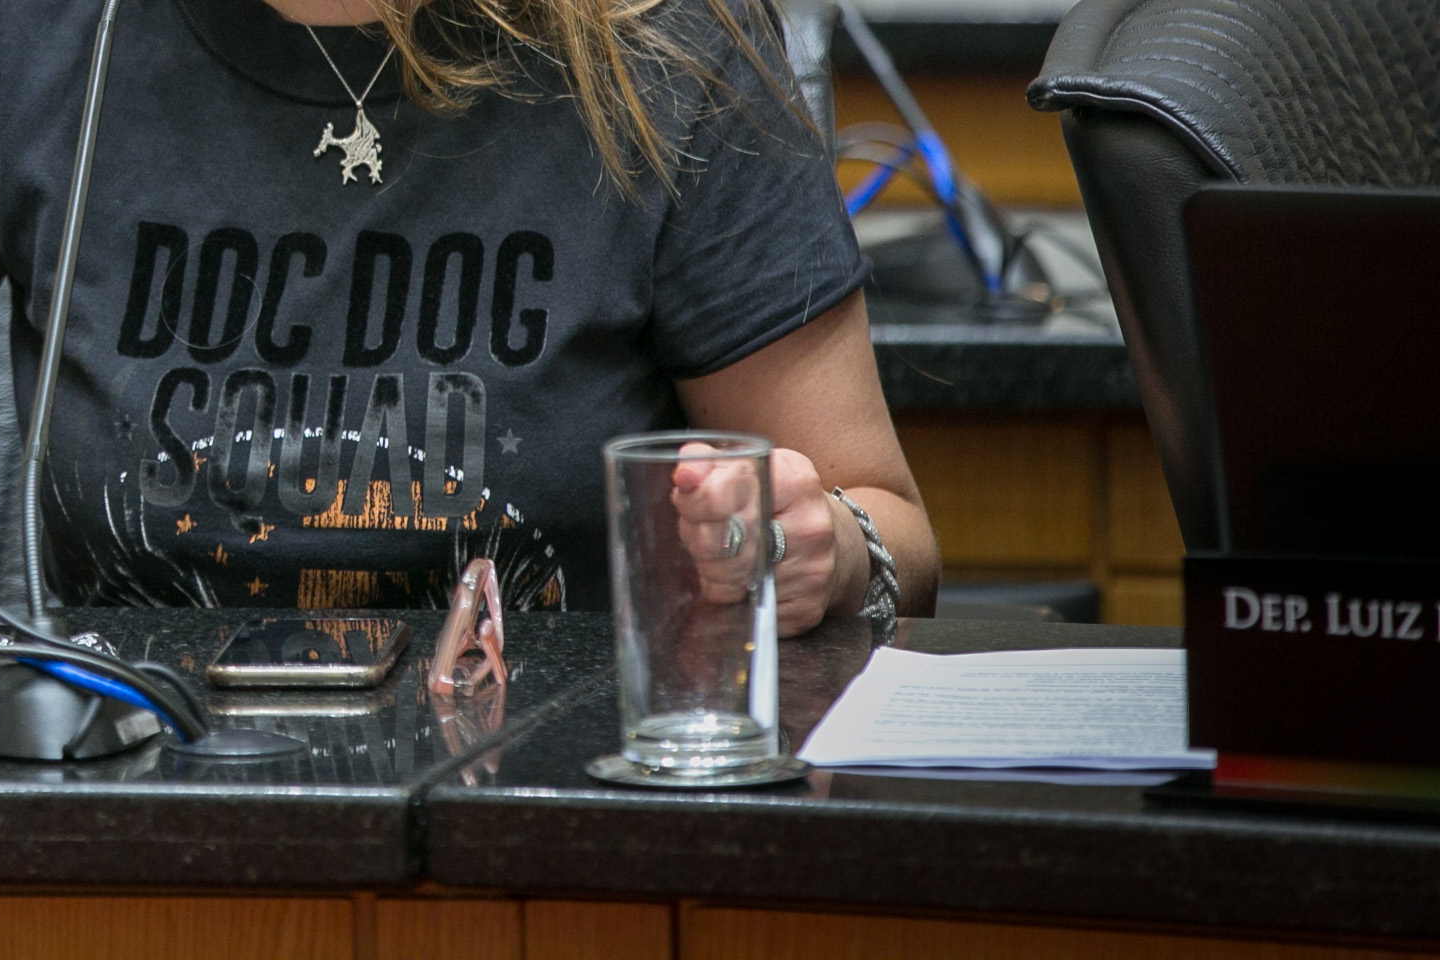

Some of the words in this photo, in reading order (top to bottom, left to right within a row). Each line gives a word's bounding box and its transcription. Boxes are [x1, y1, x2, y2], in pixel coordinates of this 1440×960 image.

[116, 221, 328, 366] DOC
[342, 230, 555, 367] DOG
[139, 367, 487, 534] SQUAD
[1223, 587, 1312, 632] DEP.
[1325, 593, 1424, 640] LUIZ
